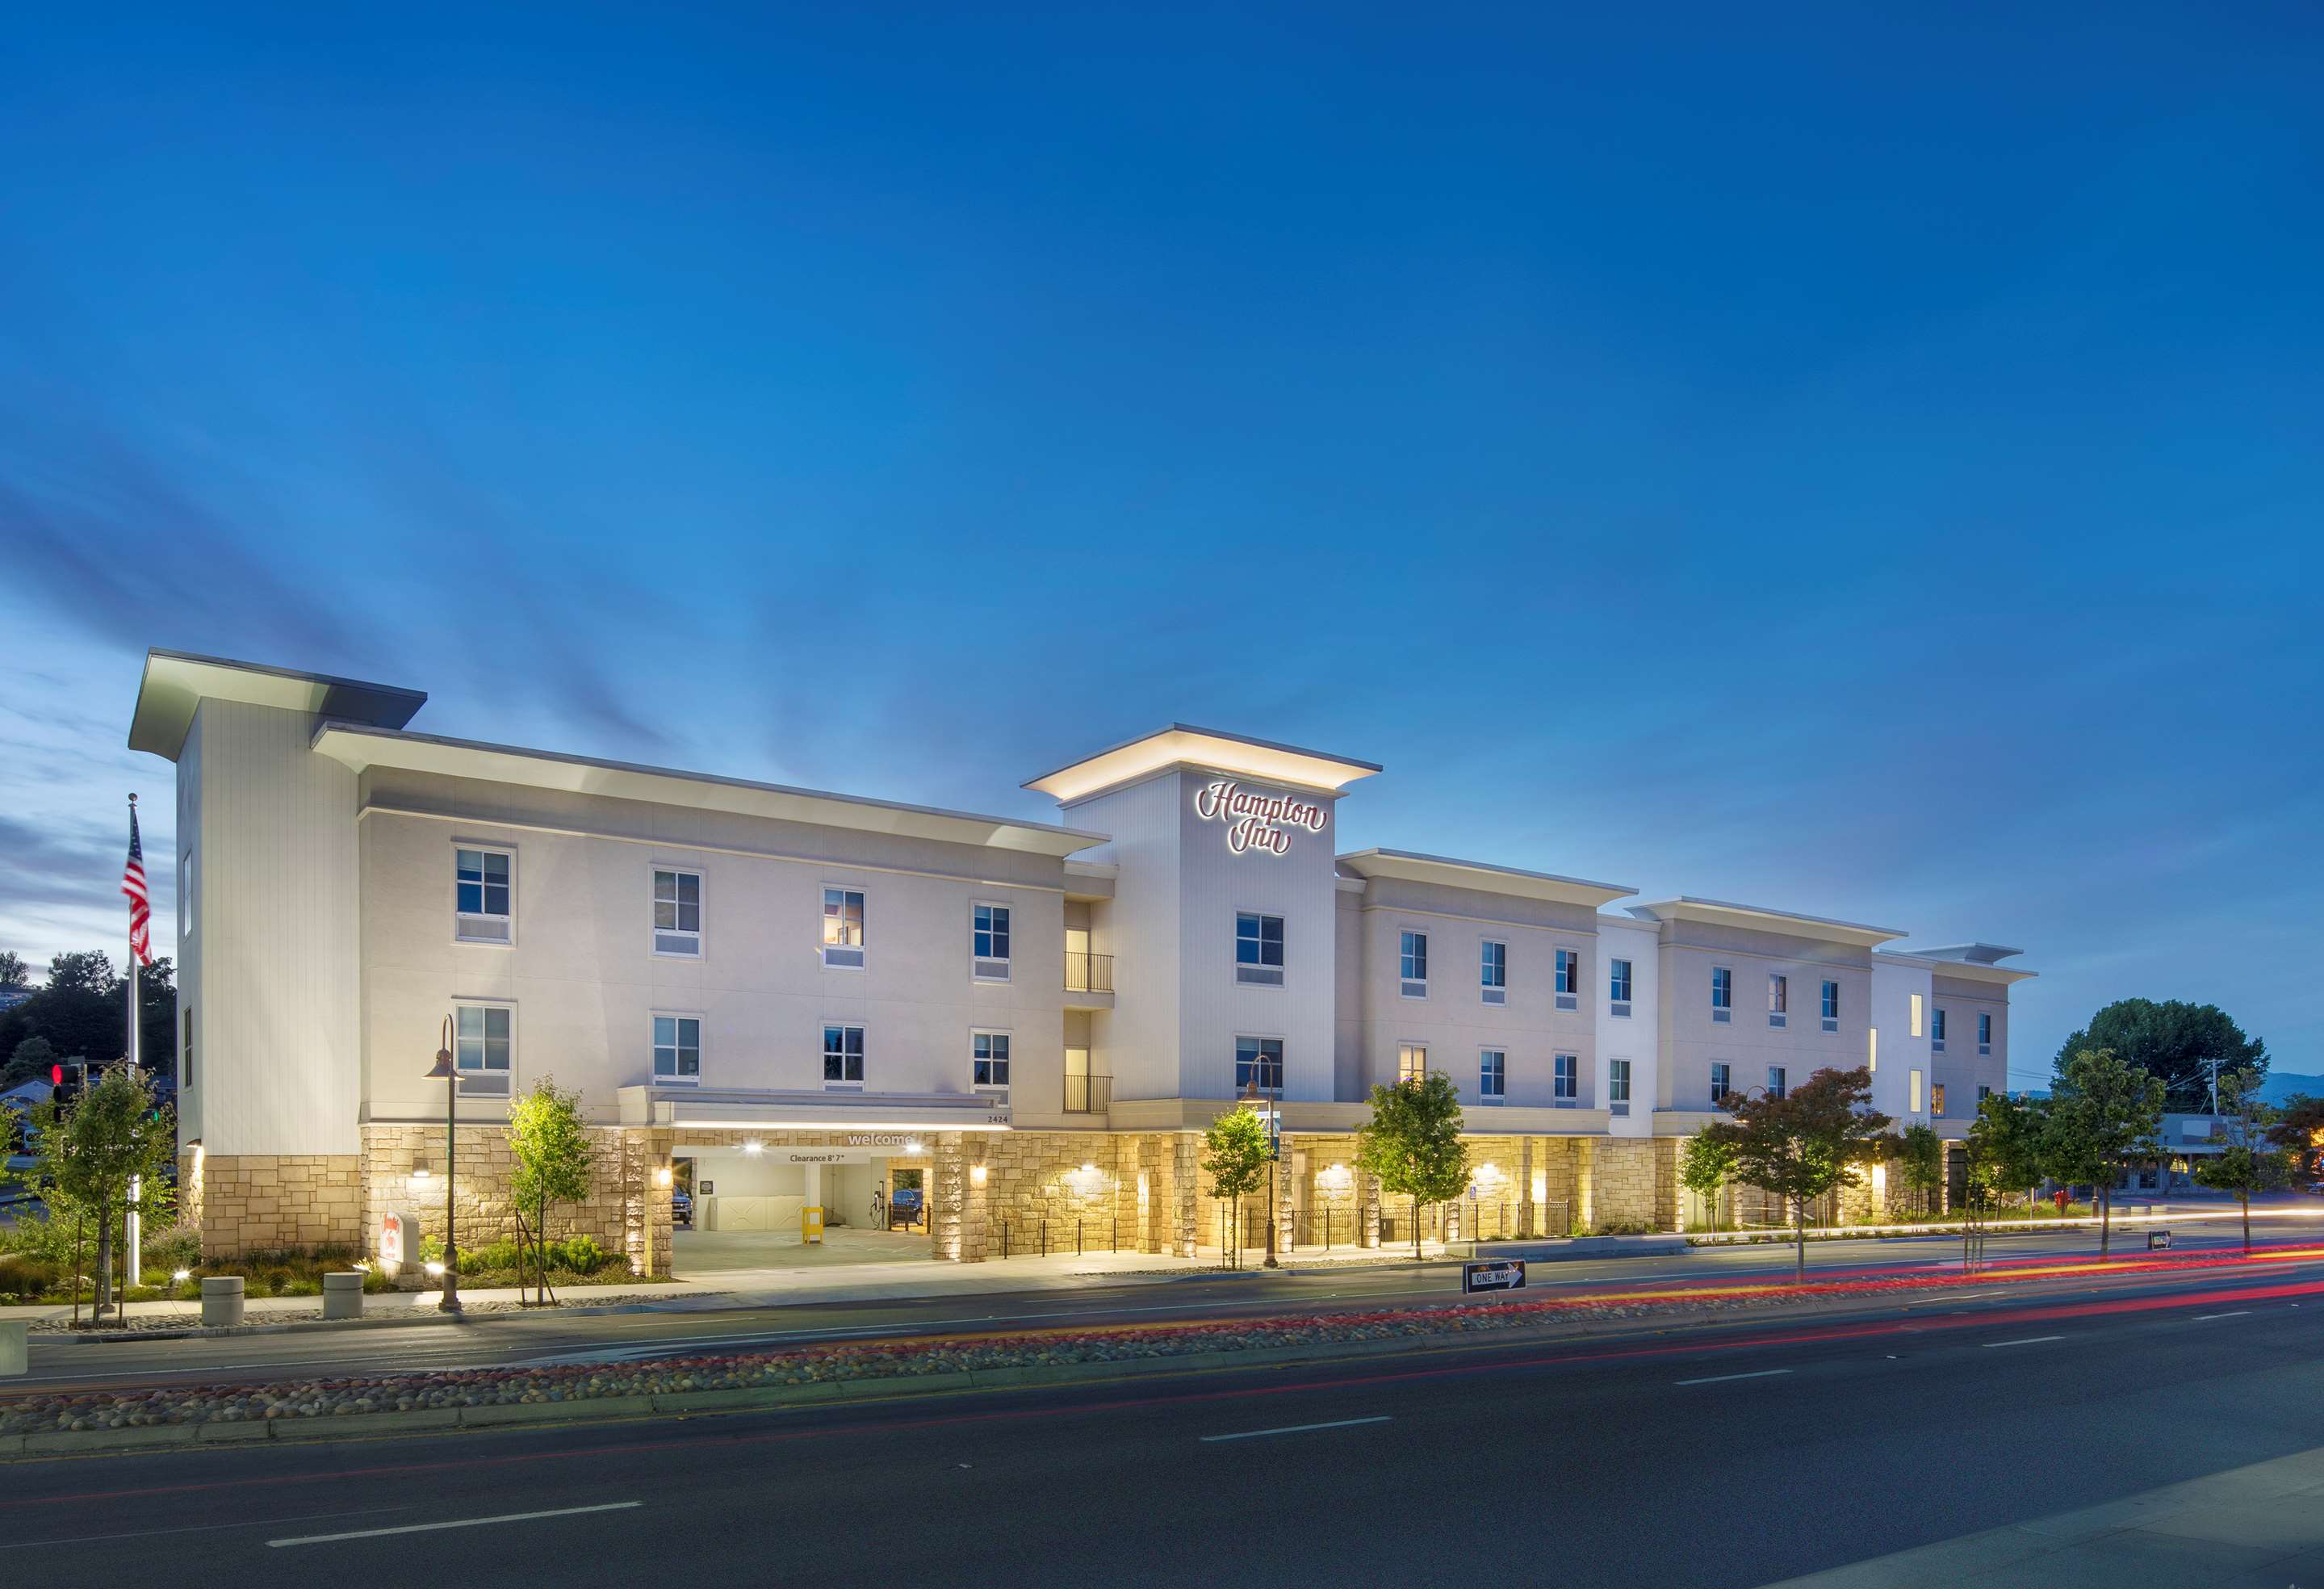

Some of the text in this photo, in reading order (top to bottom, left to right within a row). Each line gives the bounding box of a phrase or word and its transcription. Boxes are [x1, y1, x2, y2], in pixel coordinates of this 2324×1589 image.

[1198, 782, 1327, 831] Hampton
[1229, 817, 1292, 854] Inn
[848, 1133, 913, 1145] welcome
[1476, 1271, 1508, 1283] ONE WAY
